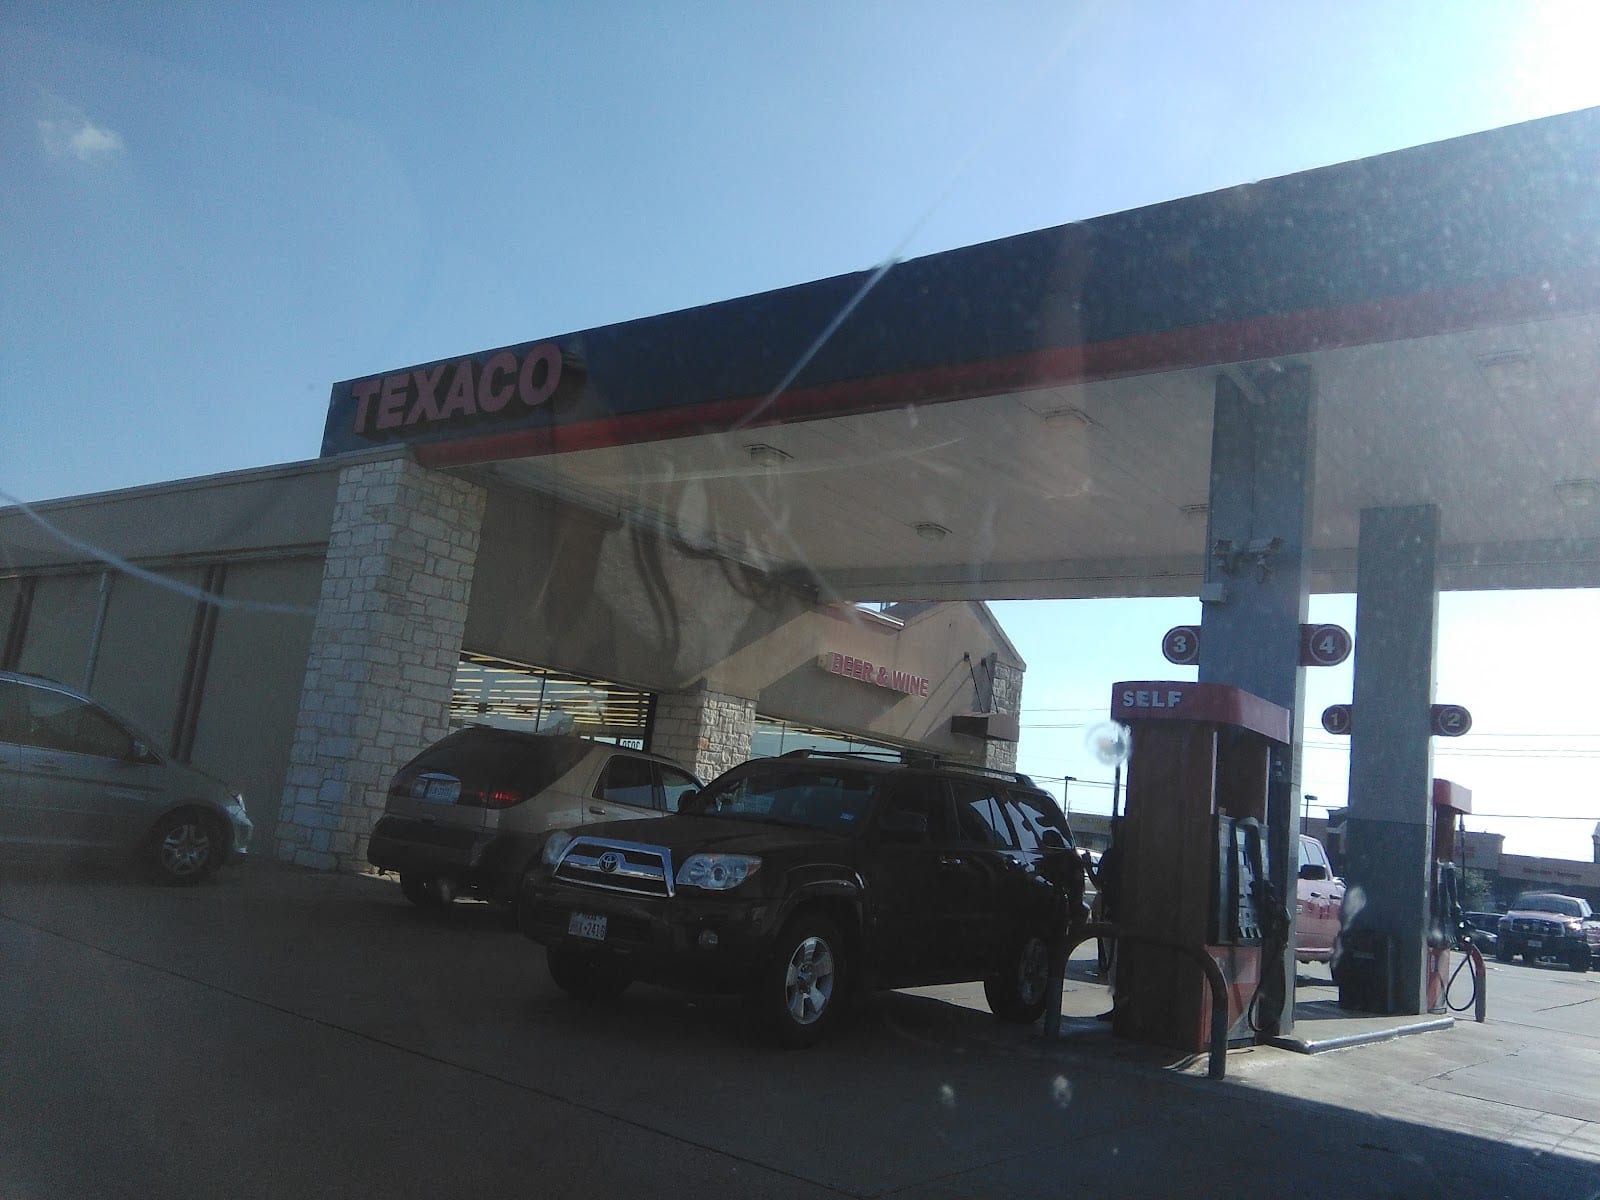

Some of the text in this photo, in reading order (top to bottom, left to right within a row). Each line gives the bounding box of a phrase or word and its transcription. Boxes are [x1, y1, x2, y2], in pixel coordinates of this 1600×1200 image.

[352, 342, 563, 434] TEXACO
[1173, 635, 1187, 653] 3
[1319, 635, 1336, 654] 4
[830, 652, 929, 699] BEER & WINE
[1122, 690, 1184, 708] SELF
[1331, 713, 1342, 727] 1
[1447, 713, 1461, 727] 2
